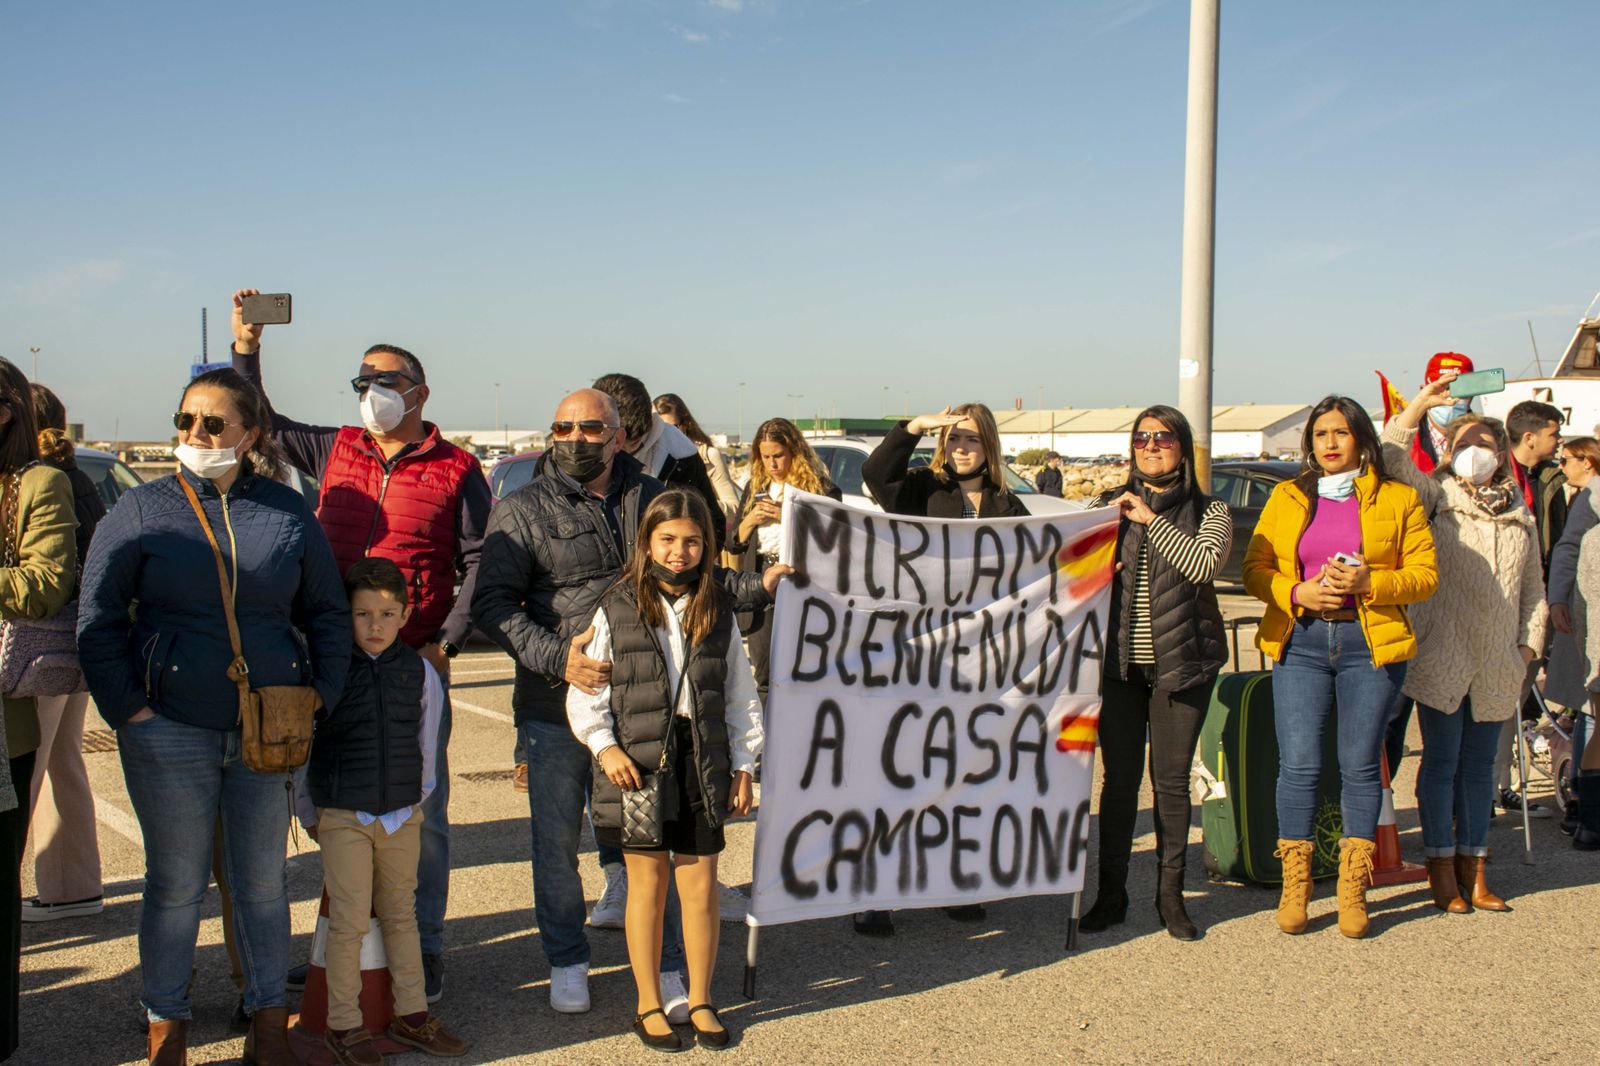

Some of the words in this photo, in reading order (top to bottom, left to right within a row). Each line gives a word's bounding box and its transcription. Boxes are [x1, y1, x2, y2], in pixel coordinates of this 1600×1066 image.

[792, 504, 1063, 605] MIRIAM
[801, 698, 844, 790] A
[881, 702, 1049, 796] CASA
